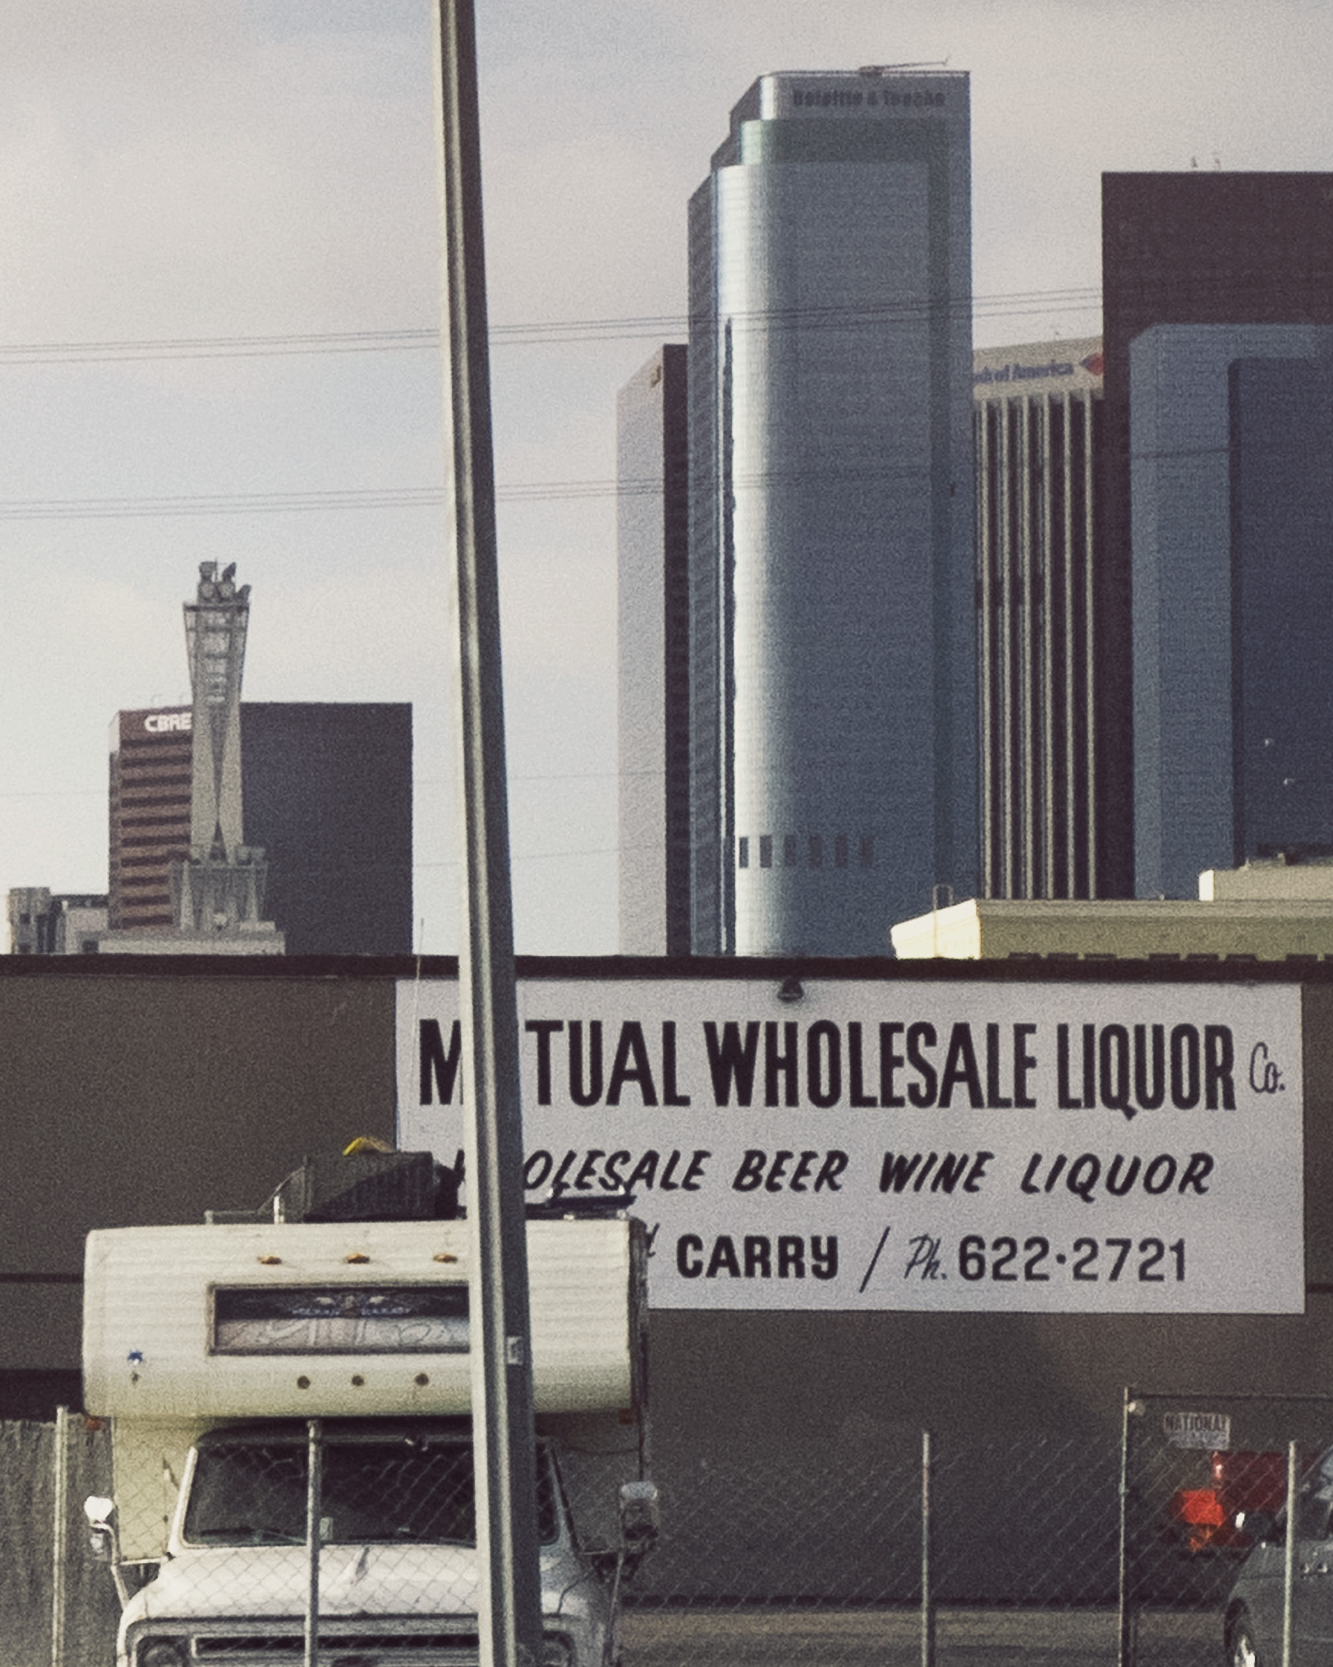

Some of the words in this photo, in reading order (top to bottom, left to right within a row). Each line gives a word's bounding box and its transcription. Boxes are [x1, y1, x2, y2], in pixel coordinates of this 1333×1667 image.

[144, 712, 193, 732] CBRE
[419, 1018, 691, 1107] MTUAL
[703, 1020, 1038, 1109] WHOLESALE
[1056, 1023, 1237, 1121] LIQUOR
[1249, 1041, 1287, 1095] Co.
[455, 1149, 712, 1198] OLESALE
[731, 1149, 849, 1193] BEER
[879, 1150, 995, 1194] WINE
[1021, 1152, 1215, 1204] LIQUOR
[676, 1233, 839, 1280] CARRY
